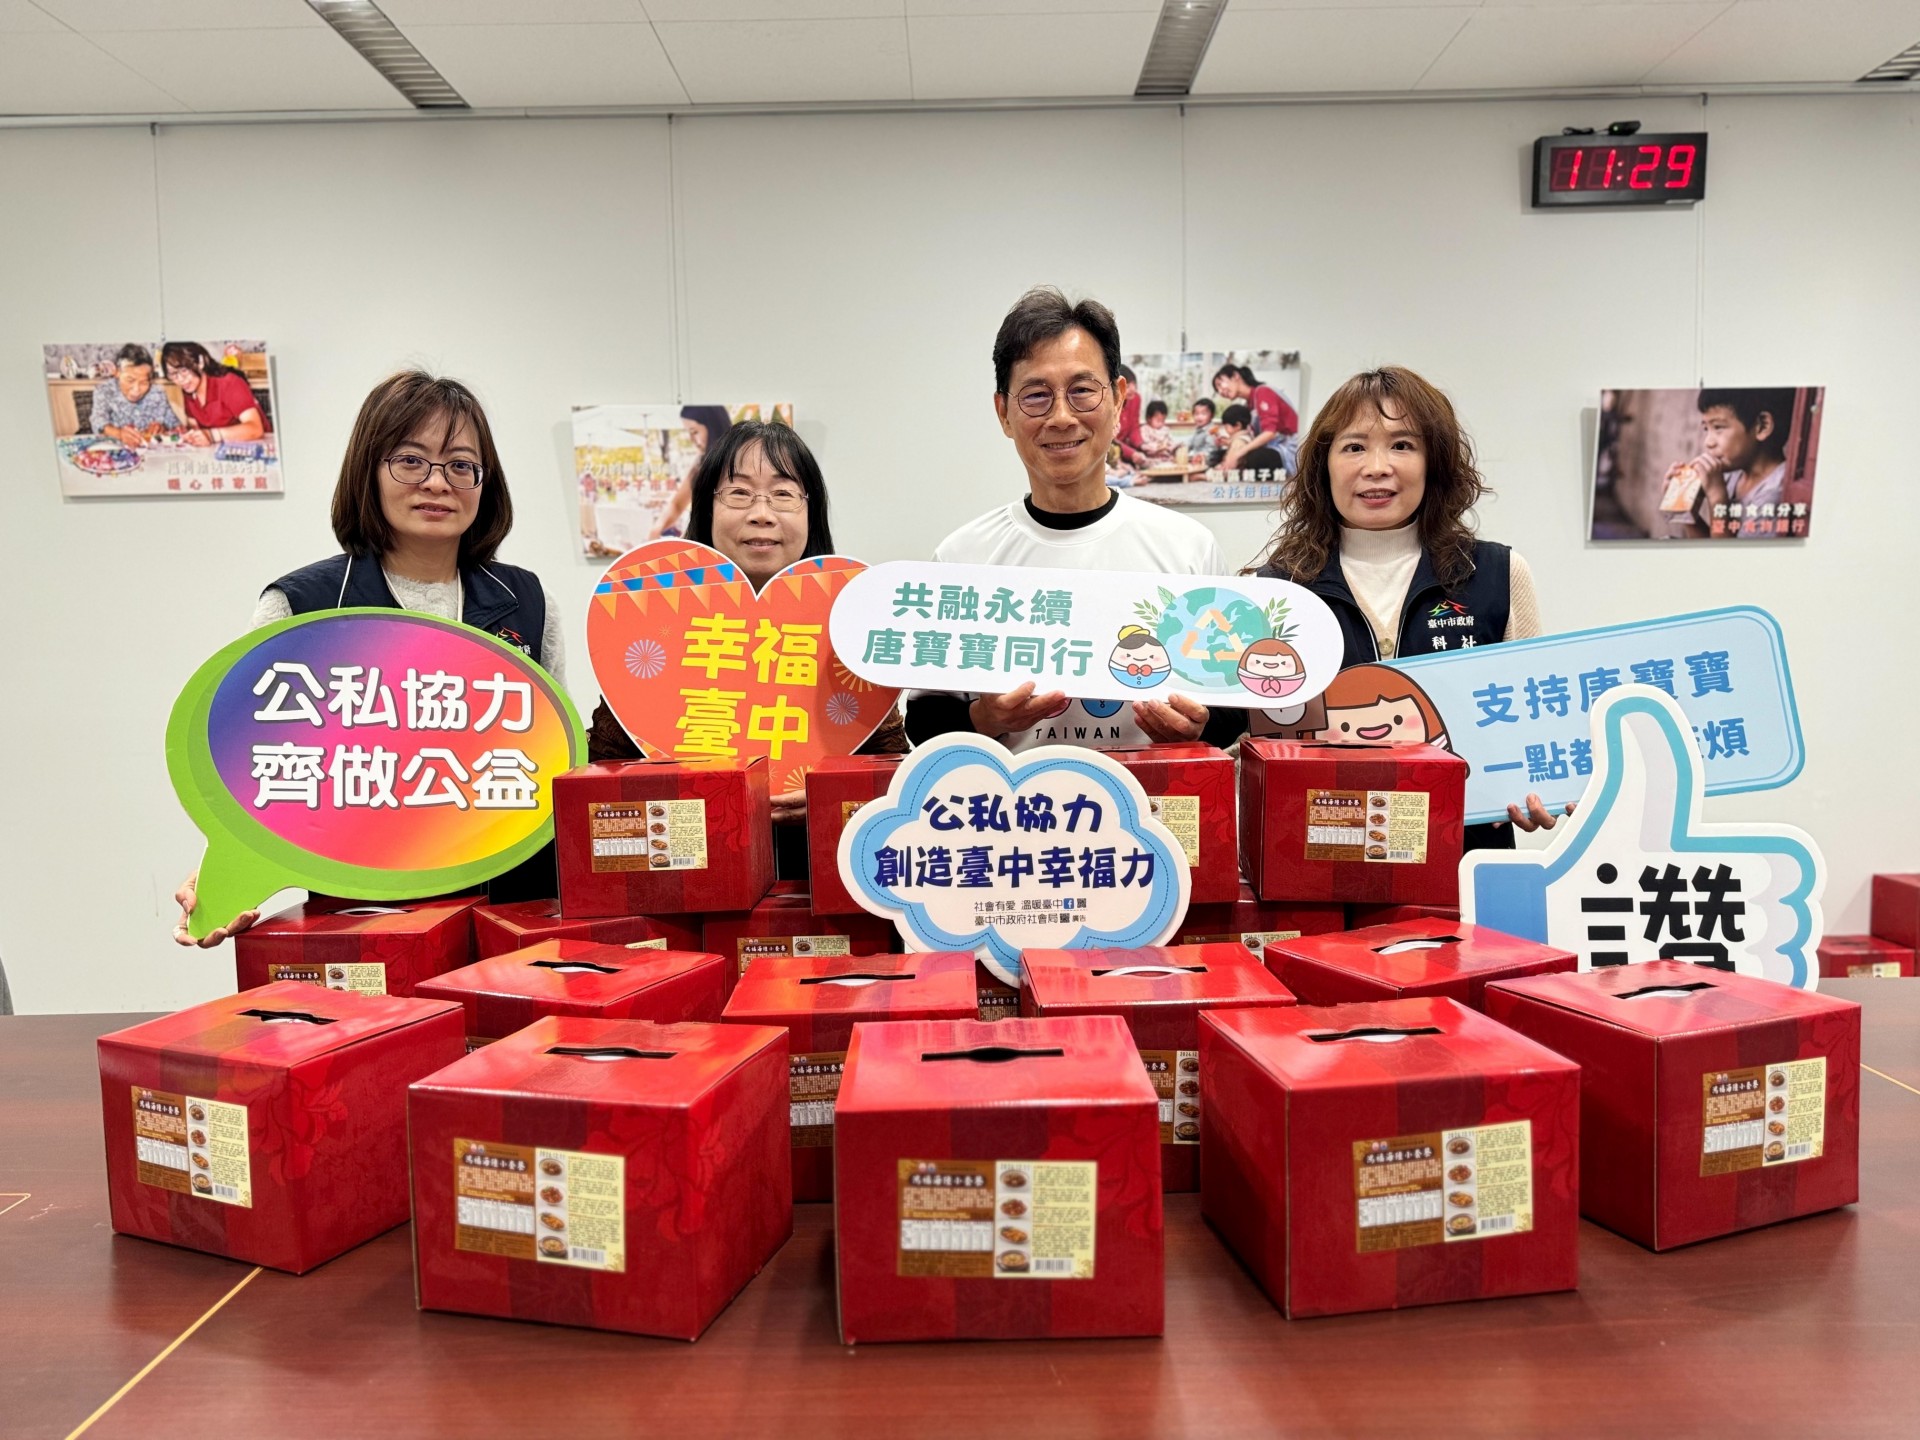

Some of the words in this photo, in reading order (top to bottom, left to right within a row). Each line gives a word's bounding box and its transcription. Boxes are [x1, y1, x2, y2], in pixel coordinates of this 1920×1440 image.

[1569, 145, 1695, 189] 11:29
[892, 581, 1073, 627] 共融永續
[1428, 616, 1474, 628] 臺中市政府
[680, 613, 822, 687] 幸福
[862, 627, 1094, 677] 唐寶寶同行
[252, 662, 534, 732] 公私協力
[673, 687, 809, 760] 臺中
[1035, 726, 1120, 740] TAIWAN
[250, 741, 538, 810] 齊做公益
[922, 793, 1102, 832] 公私協力
[874, 846, 1154, 889] 創造臺中幸福力
[974, 900, 1016, 912] 社會有愛
[1021, 899, 1062, 910] 溫暖臺中
[975, 913, 1058, 926] 臺中市政府社會局
